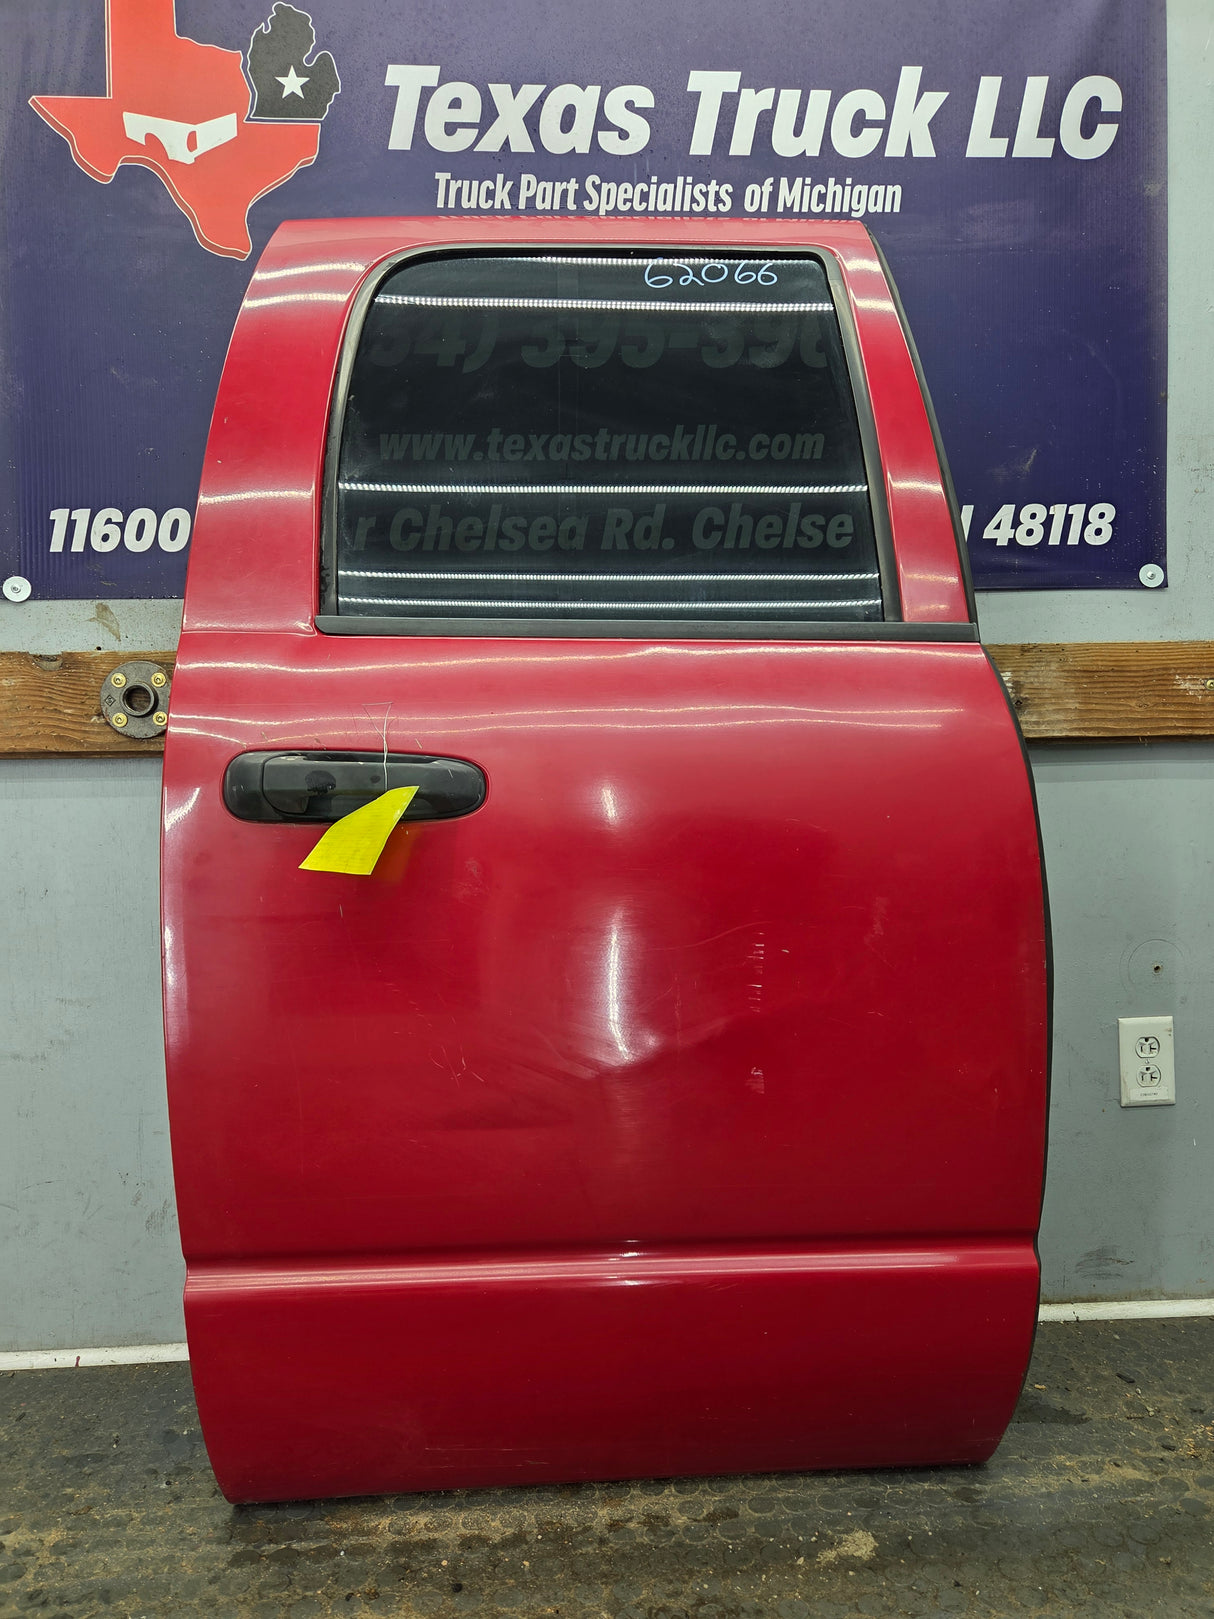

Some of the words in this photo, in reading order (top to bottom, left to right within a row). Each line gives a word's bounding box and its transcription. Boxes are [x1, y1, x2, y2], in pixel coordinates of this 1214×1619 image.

[384, 64, 655, 155] Texas
[686, 66, 949, 158] Truck
[965, 75, 1122, 160] LLC
[435, 172, 514, 210] Truck
[518, 173, 578, 210] Part
[583, 174, 733, 215] Specialists
[744, 177, 773, 212] of
[777, 177, 902, 218] Michigan
[644, 258, 778, 288] 62066
[378, 424, 825, 461] www.texastruckllc.com
[49, 507, 192, 553] 11600
[389, 504, 590, 551] Chelsea
[600, 503, 675, 551] Rd.
[692, 502, 854, 550] Chelse
[982, 502, 1116, 546] 48118
